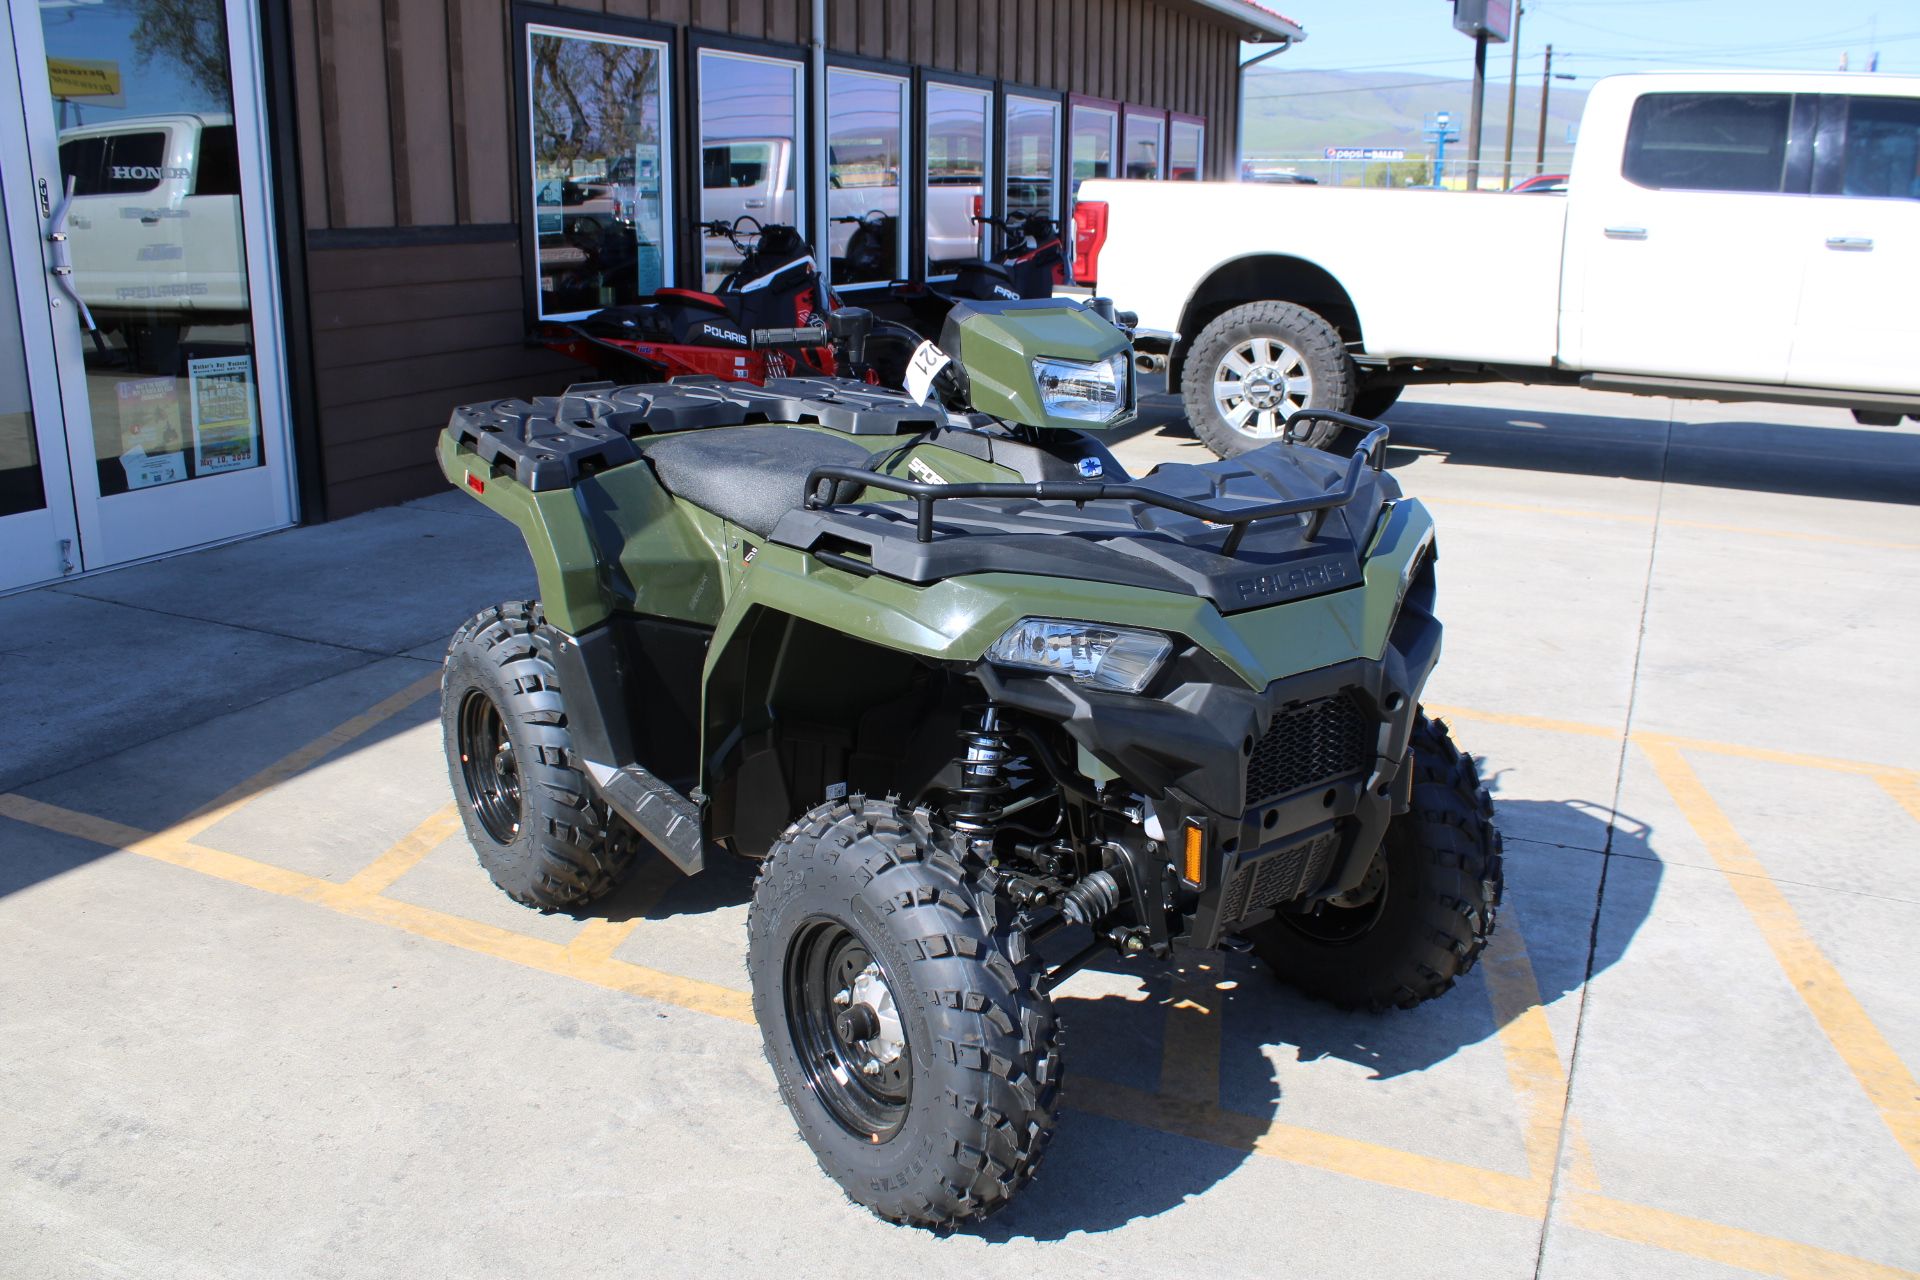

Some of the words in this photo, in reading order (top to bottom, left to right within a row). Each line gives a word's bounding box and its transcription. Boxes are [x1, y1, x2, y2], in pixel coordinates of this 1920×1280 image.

[1336, 149, 1364, 160] pepsi
[112, 166, 192, 180] HONDA
[39, 179, 49, 213] PULL
[703, 324, 748, 345] POLARIS
[1237, 562, 1347, 601] POLARIS
